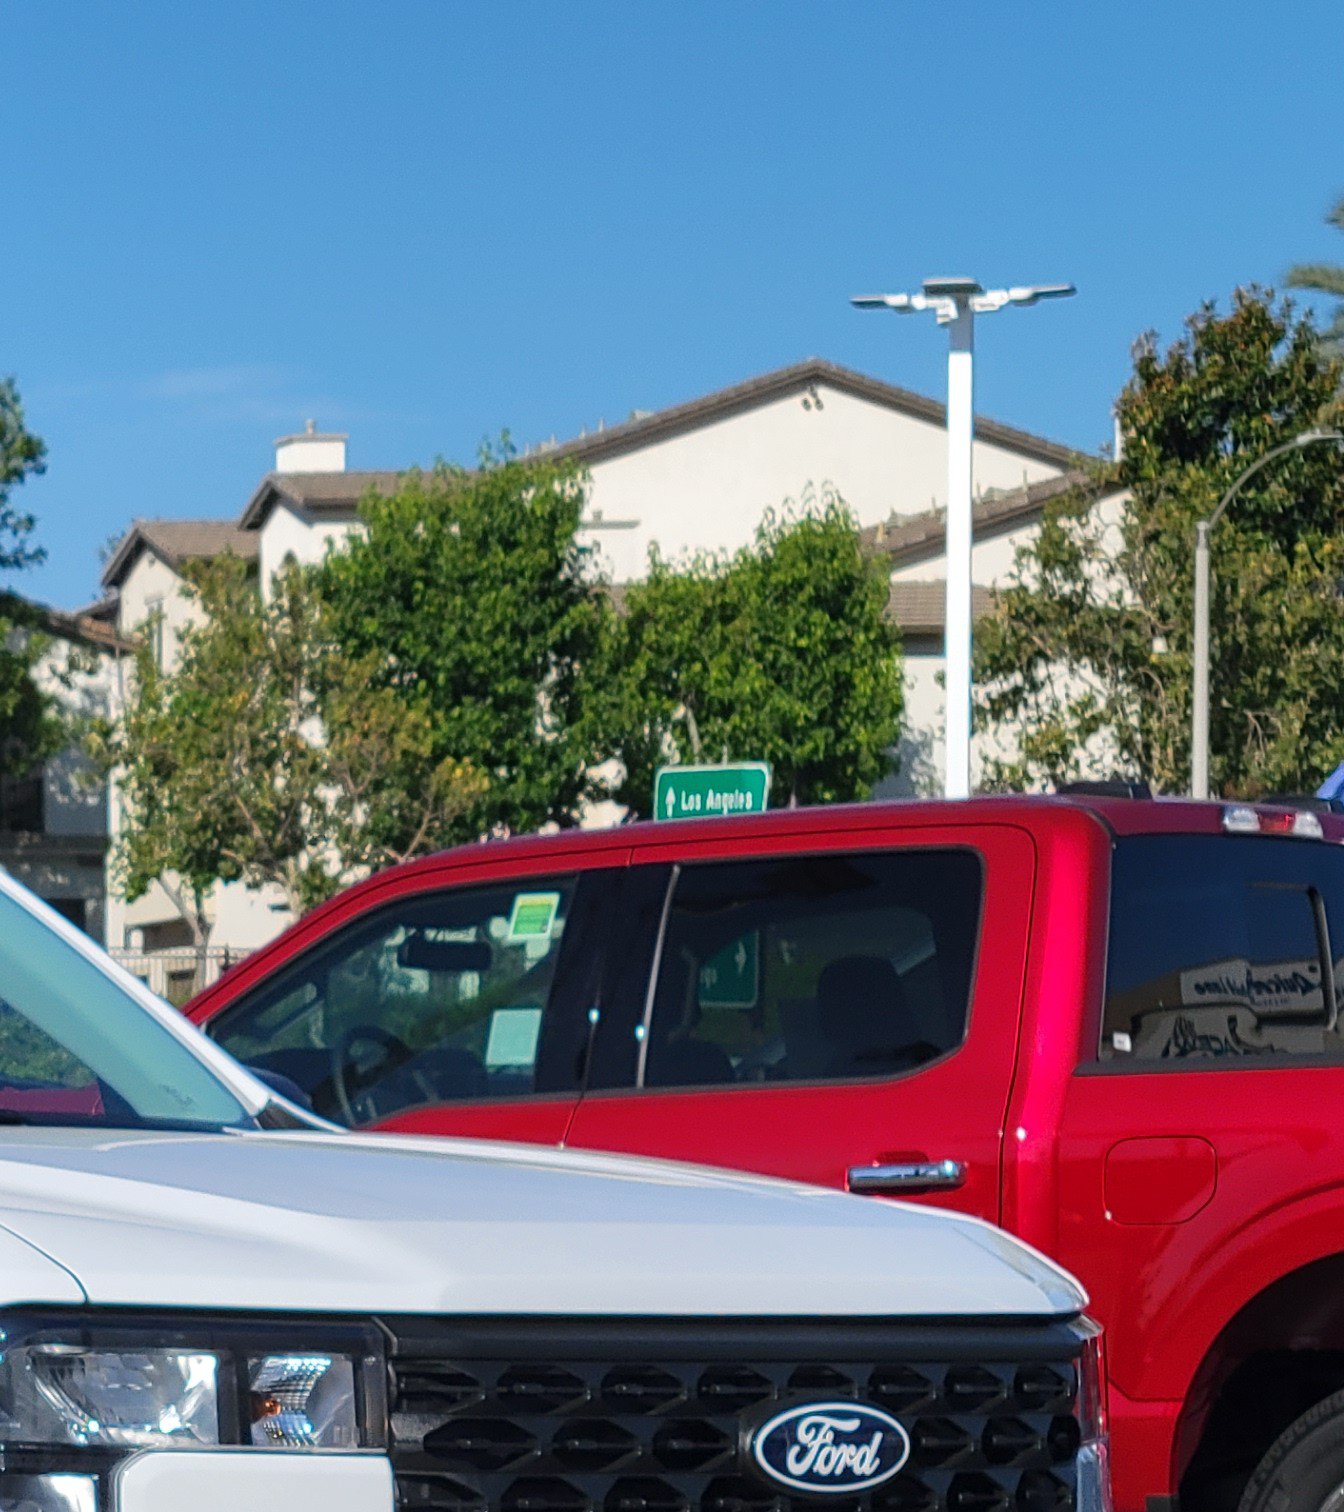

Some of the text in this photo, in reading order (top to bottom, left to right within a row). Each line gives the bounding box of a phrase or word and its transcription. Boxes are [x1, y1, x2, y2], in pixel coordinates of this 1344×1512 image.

[681, 789, 752, 816] Los Angeles
[786, 1415, 883, 1476] Ford
